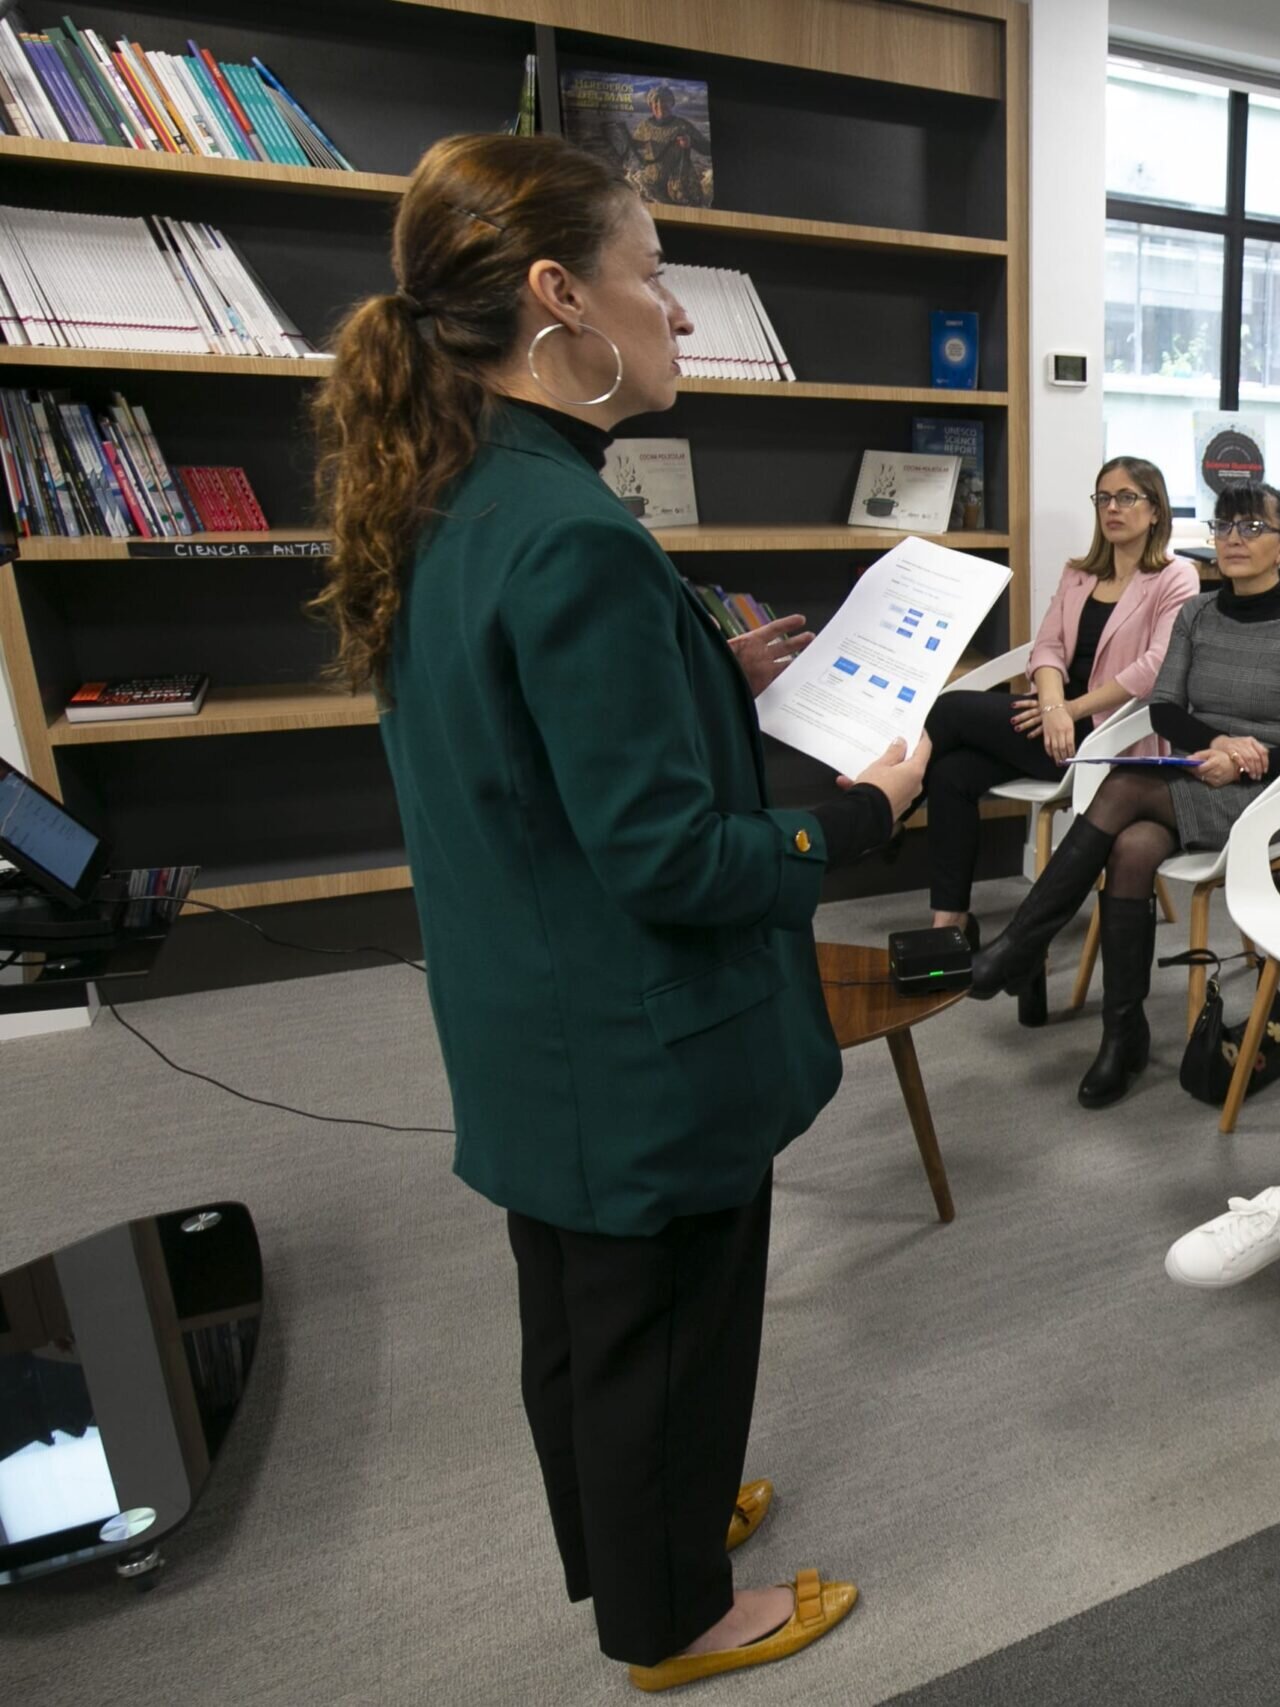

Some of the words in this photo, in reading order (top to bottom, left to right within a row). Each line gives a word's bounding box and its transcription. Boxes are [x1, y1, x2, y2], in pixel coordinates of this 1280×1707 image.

[575, 79, 634, 92] HEREDEROS
[604, 92, 633, 103] MAR
[944, 426, 977, 437] UNESCO
[944, 435, 977, 446] SCIENCE
[944, 445, 977, 455] REPORT
